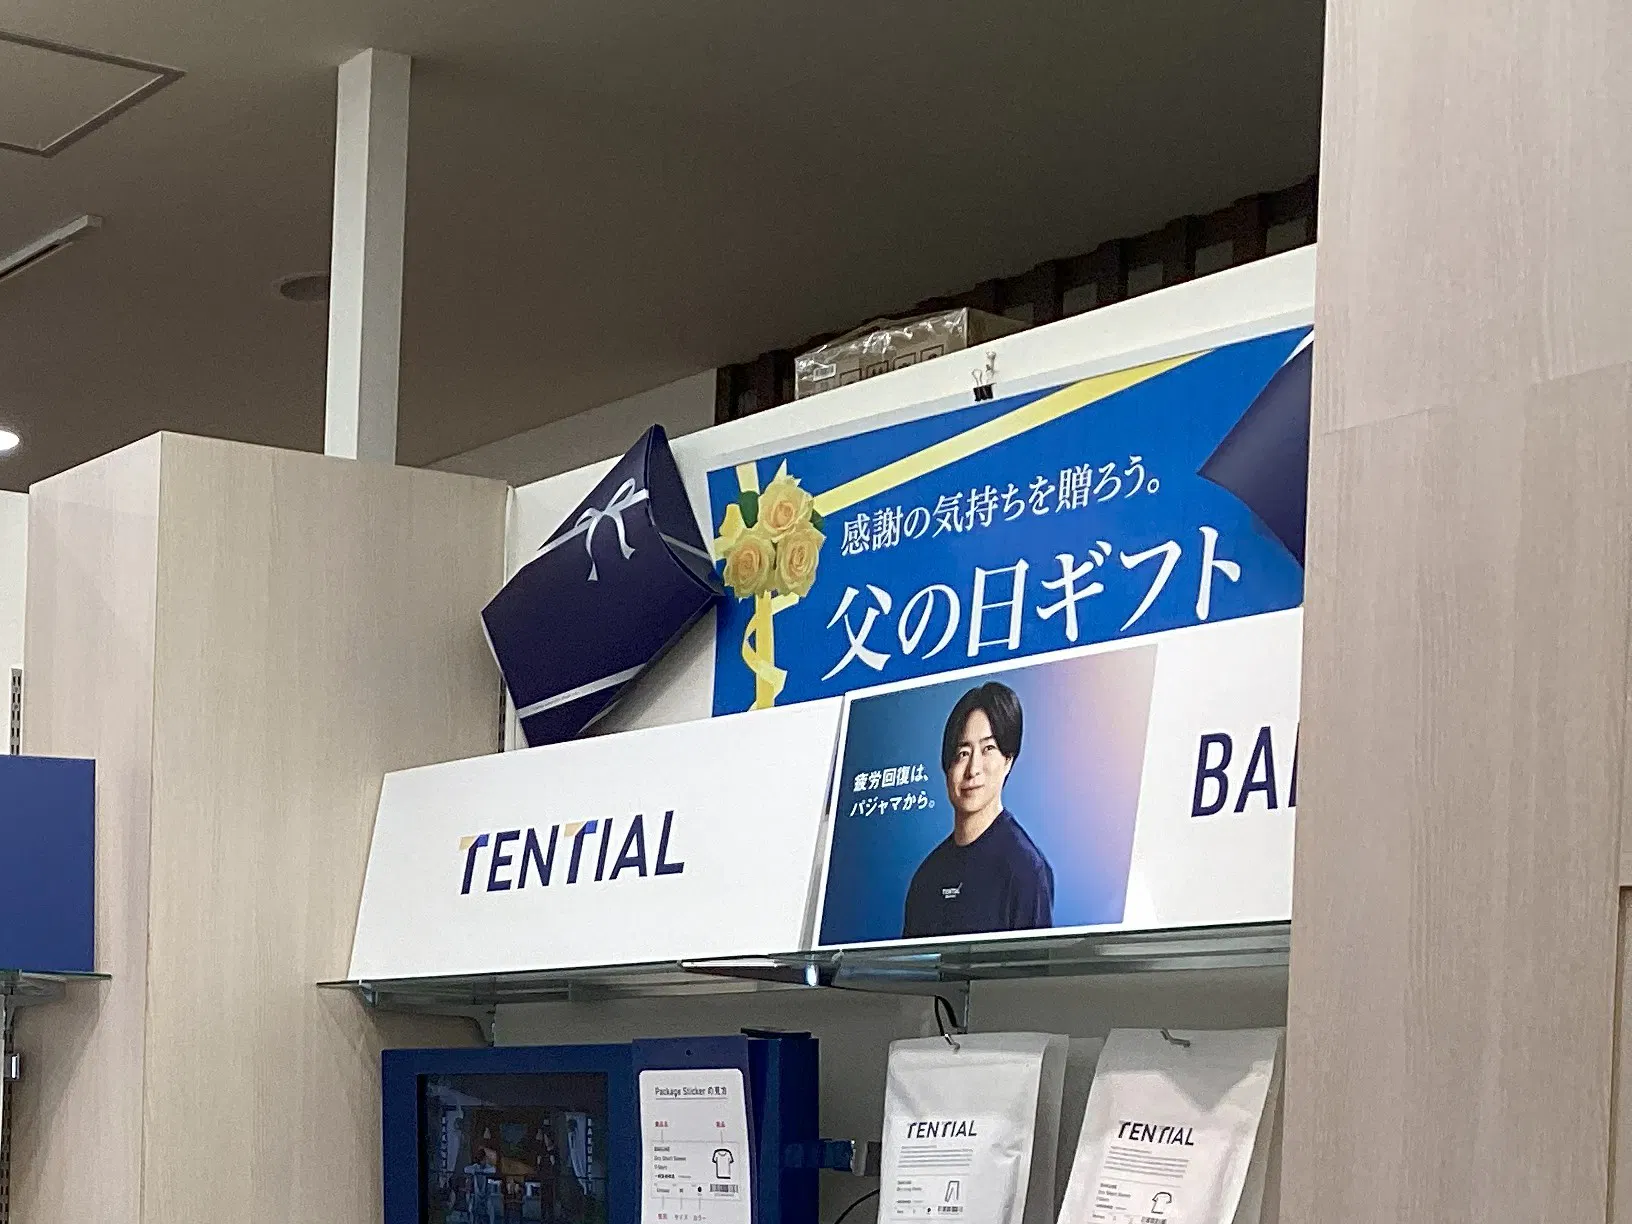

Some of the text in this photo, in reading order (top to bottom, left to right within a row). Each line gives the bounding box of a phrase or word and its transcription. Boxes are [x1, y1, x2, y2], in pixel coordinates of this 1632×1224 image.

[840, 454, 1161, 557] 感謝の気持ちを贈ろう。
[821, 525, 1242, 682] 父の日ギフト
[852, 763, 930, 793] 疲労回復は、
[1191, 723, 1300, 818] BA
[849, 790, 936, 818] パジャマから。
[459, 810, 685, 895] TENTIAL
[906, 1120, 977, 1139] TENTIAL
[1117, 1121, 1194, 1146] TENTIAL
